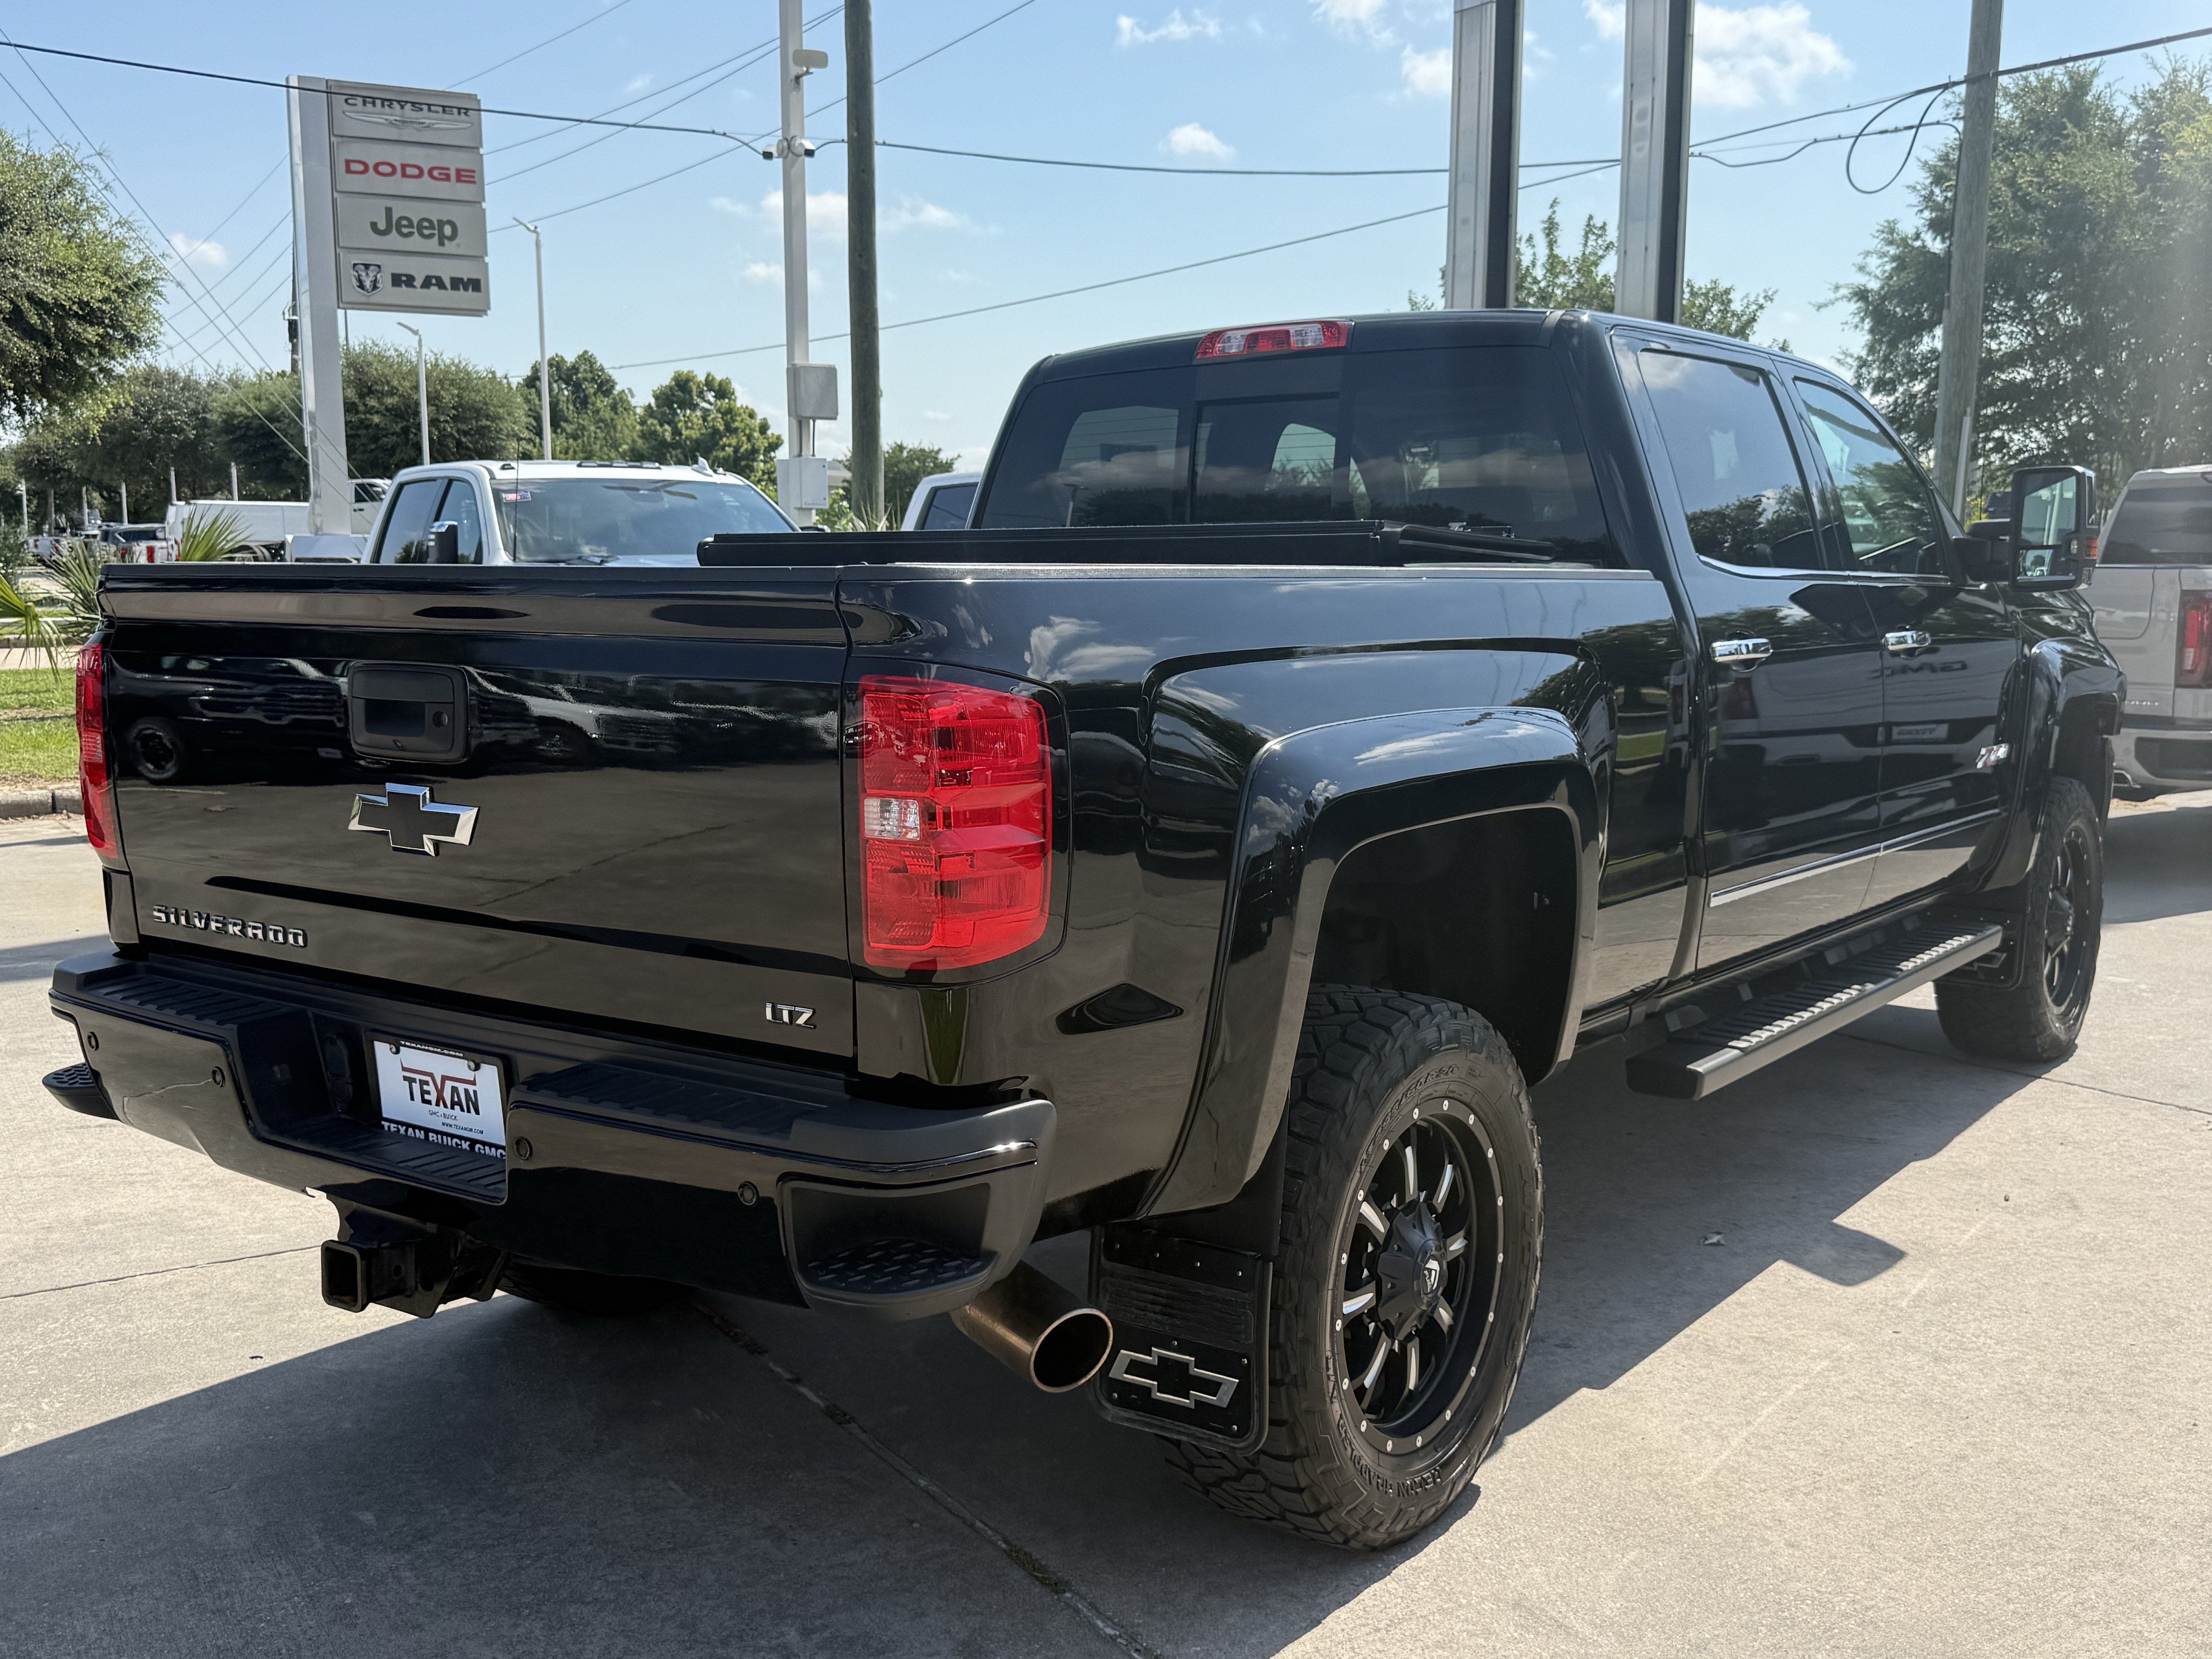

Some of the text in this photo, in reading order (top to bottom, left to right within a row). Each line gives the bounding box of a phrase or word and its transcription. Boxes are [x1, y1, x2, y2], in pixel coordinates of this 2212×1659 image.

[344, 97, 471, 117] CHRYSLER
[344, 158, 477, 185] DODGE
[370, 206, 459, 247] Jeep
[391, 272, 482, 293] RAM
[153, 904, 308, 948] SILVERADO
[765, 1002, 816, 1029] LTZ
[400, 1041, 464, 1057] TEXANGM.COM
[400, 1058, 480, 1116] TEXAN
[428, 1109, 440, 1118] GMC
[381, 1121, 506, 1159] TEXAN BUICK GMC
